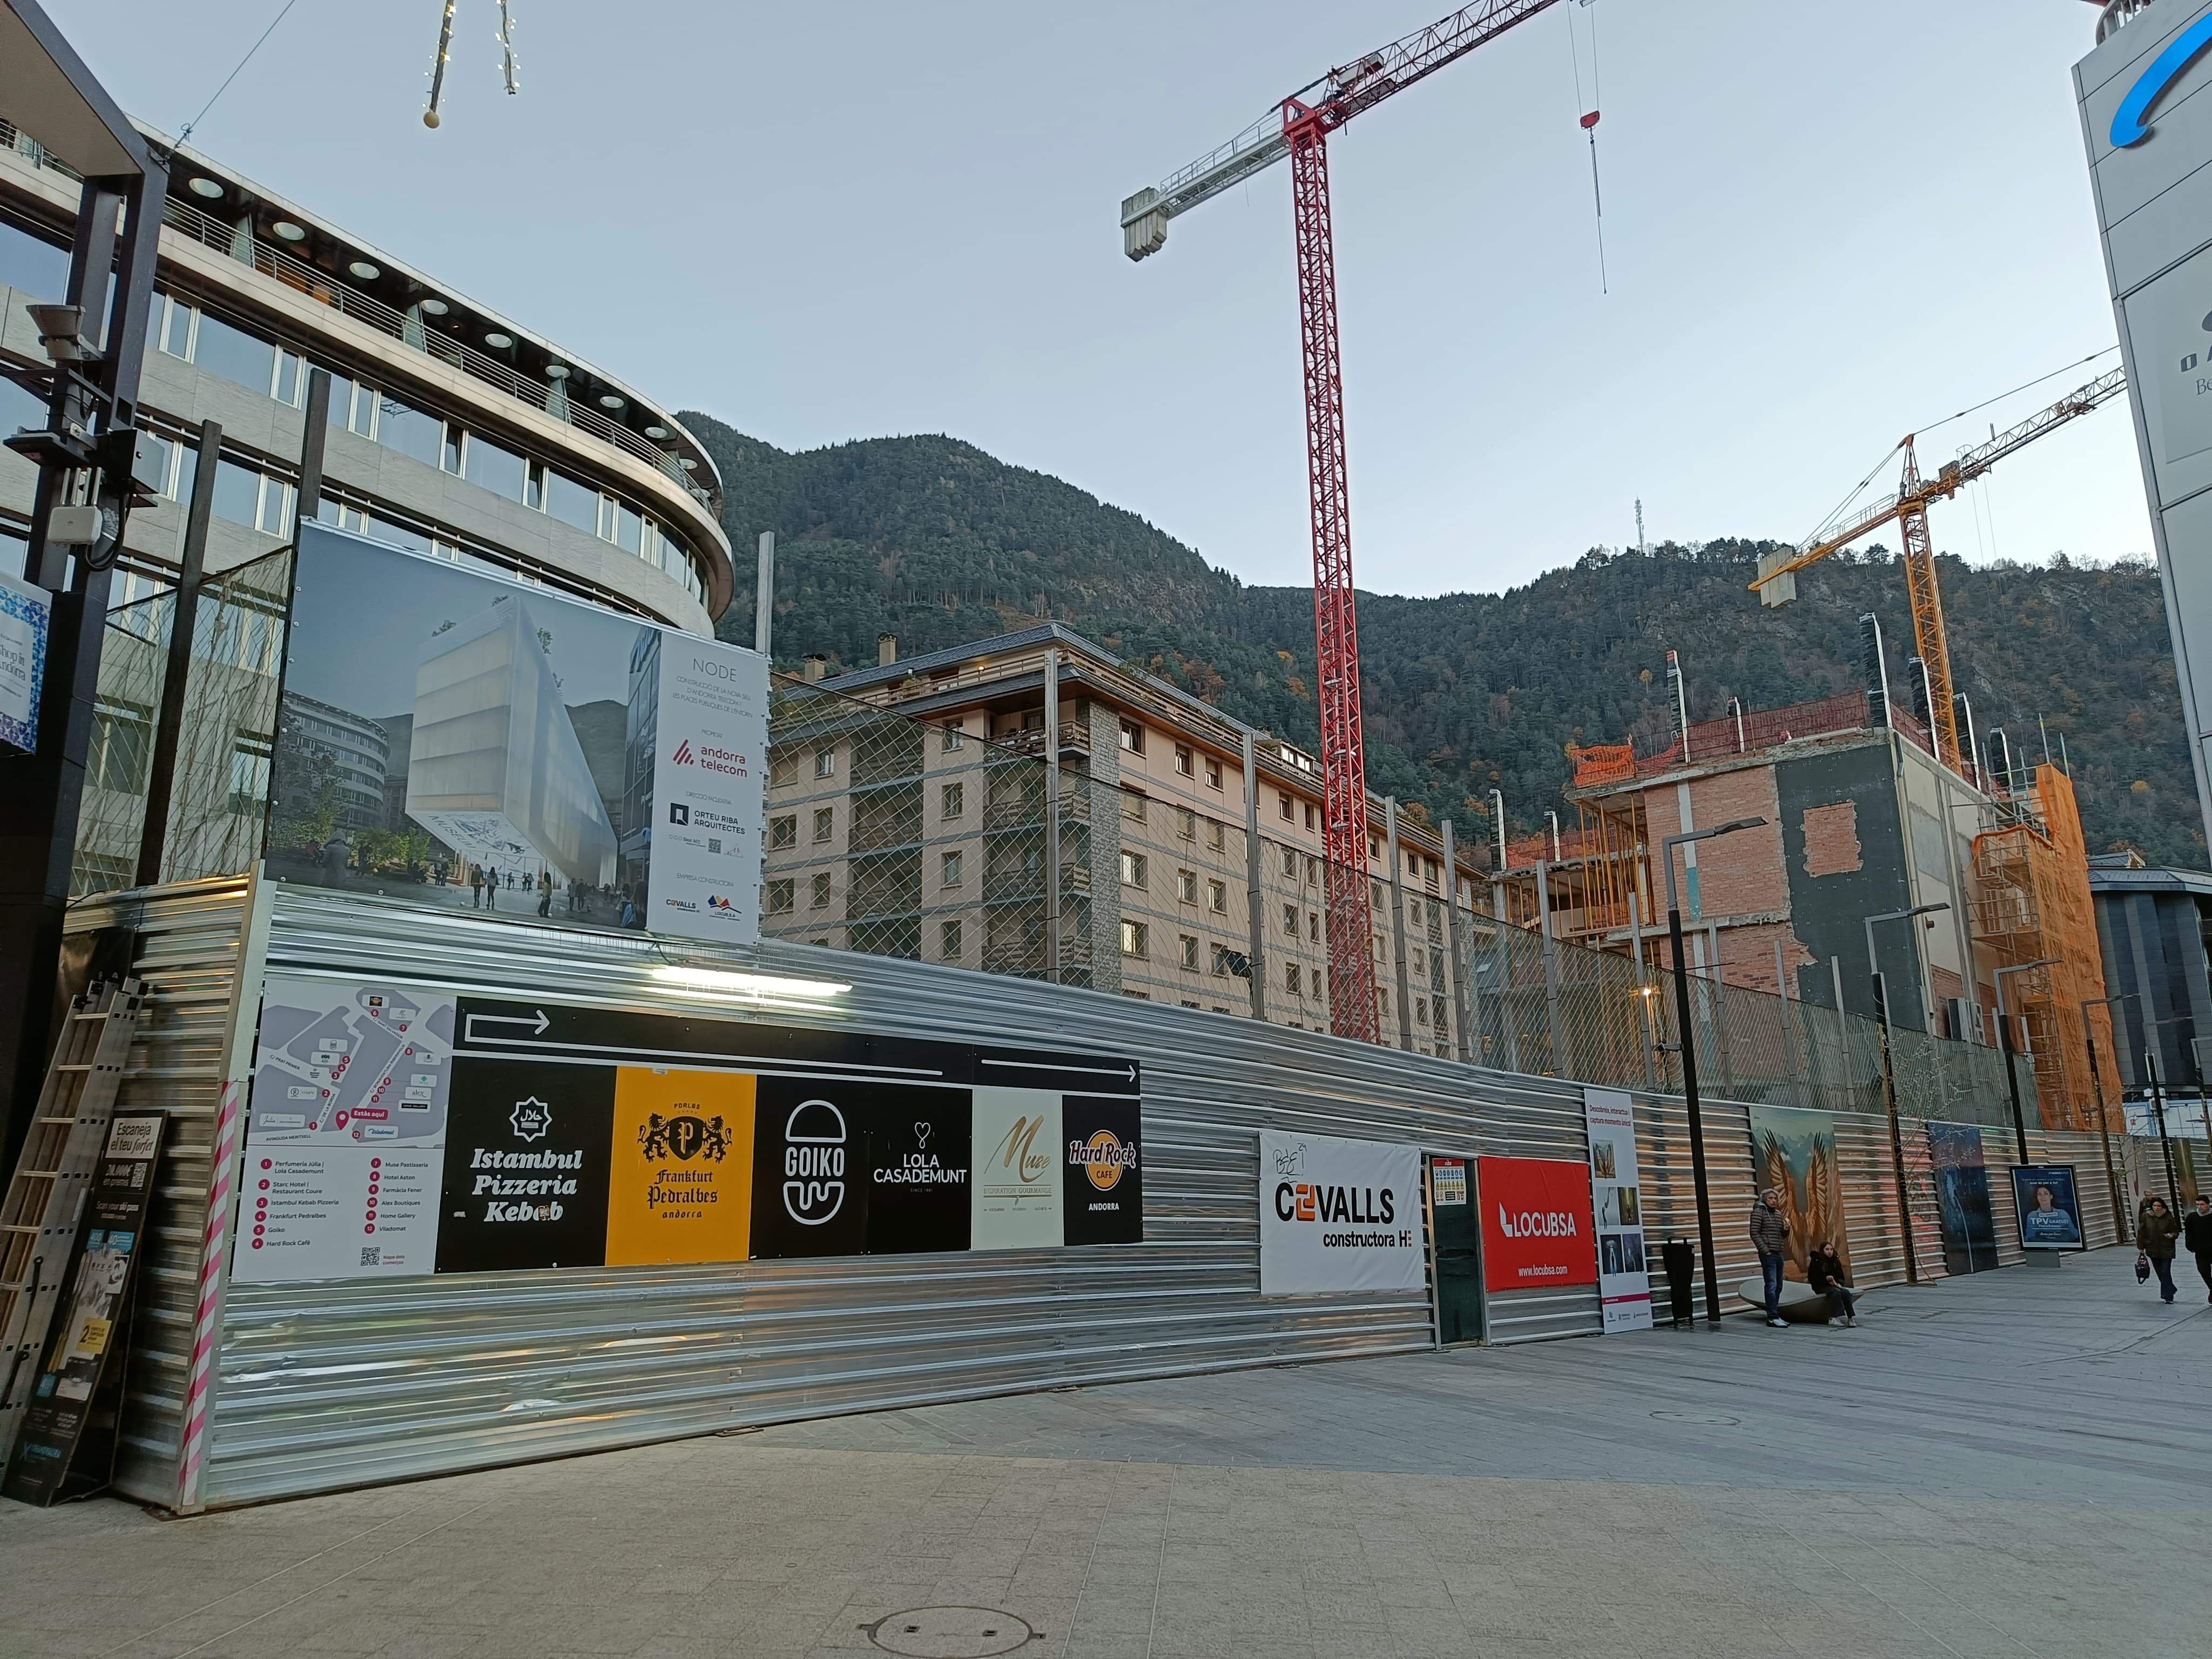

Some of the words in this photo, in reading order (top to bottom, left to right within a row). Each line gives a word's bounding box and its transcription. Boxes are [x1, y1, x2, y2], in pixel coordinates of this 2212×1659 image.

[0, 644, 17, 664] hop
[0, 661, 25, 680] ndorra
[693, 658, 737, 682] NODE
[701, 746, 745, 764] andorra
[700, 758, 747, 778] telecom
[694, 810, 720, 821] ORTEU
[721, 815, 738, 825] RIBA
[694, 819, 745, 834] ARQUITECTES
[286, 1060, 300, 1071] PRIMER
[412, 1089, 427, 1098] alex
[1590, 1117, 1604, 1125] captura
[1604, 1118, 1621, 1126] moments
[117, 1122, 151, 1138] Escaneja
[111, 1137, 119, 1151] el
[119, 1139, 132, 1151] teu
[131, 1138, 153, 1154] forfet
[983, 1115, 1051, 1183] Muse
[470, 1148, 583, 1169] Istambul
[785, 1147, 845, 1177] GOIKO
[903, 1154, 940, 1168] LOLA
[1069, 1141, 1105, 1164] Hard
[1104, 1141, 1136, 1169] Rock
[653, 1169, 713, 1185] Frankfurt
[873, 1168, 967, 1184] CASADEMUNT
[1096, 1171, 1112, 1179] CAFE
[471, 1174, 577, 1195] Pizzeria
[647, 1185, 718, 1209] Pedralbes
[663, 1209, 702, 1219] andorra
[1088, 1203, 1120, 1211] ANDORRA
[1323, 1231, 1395, 1248] constructora
[1518, 1263, 1568, 1277] www.locubsa.com
